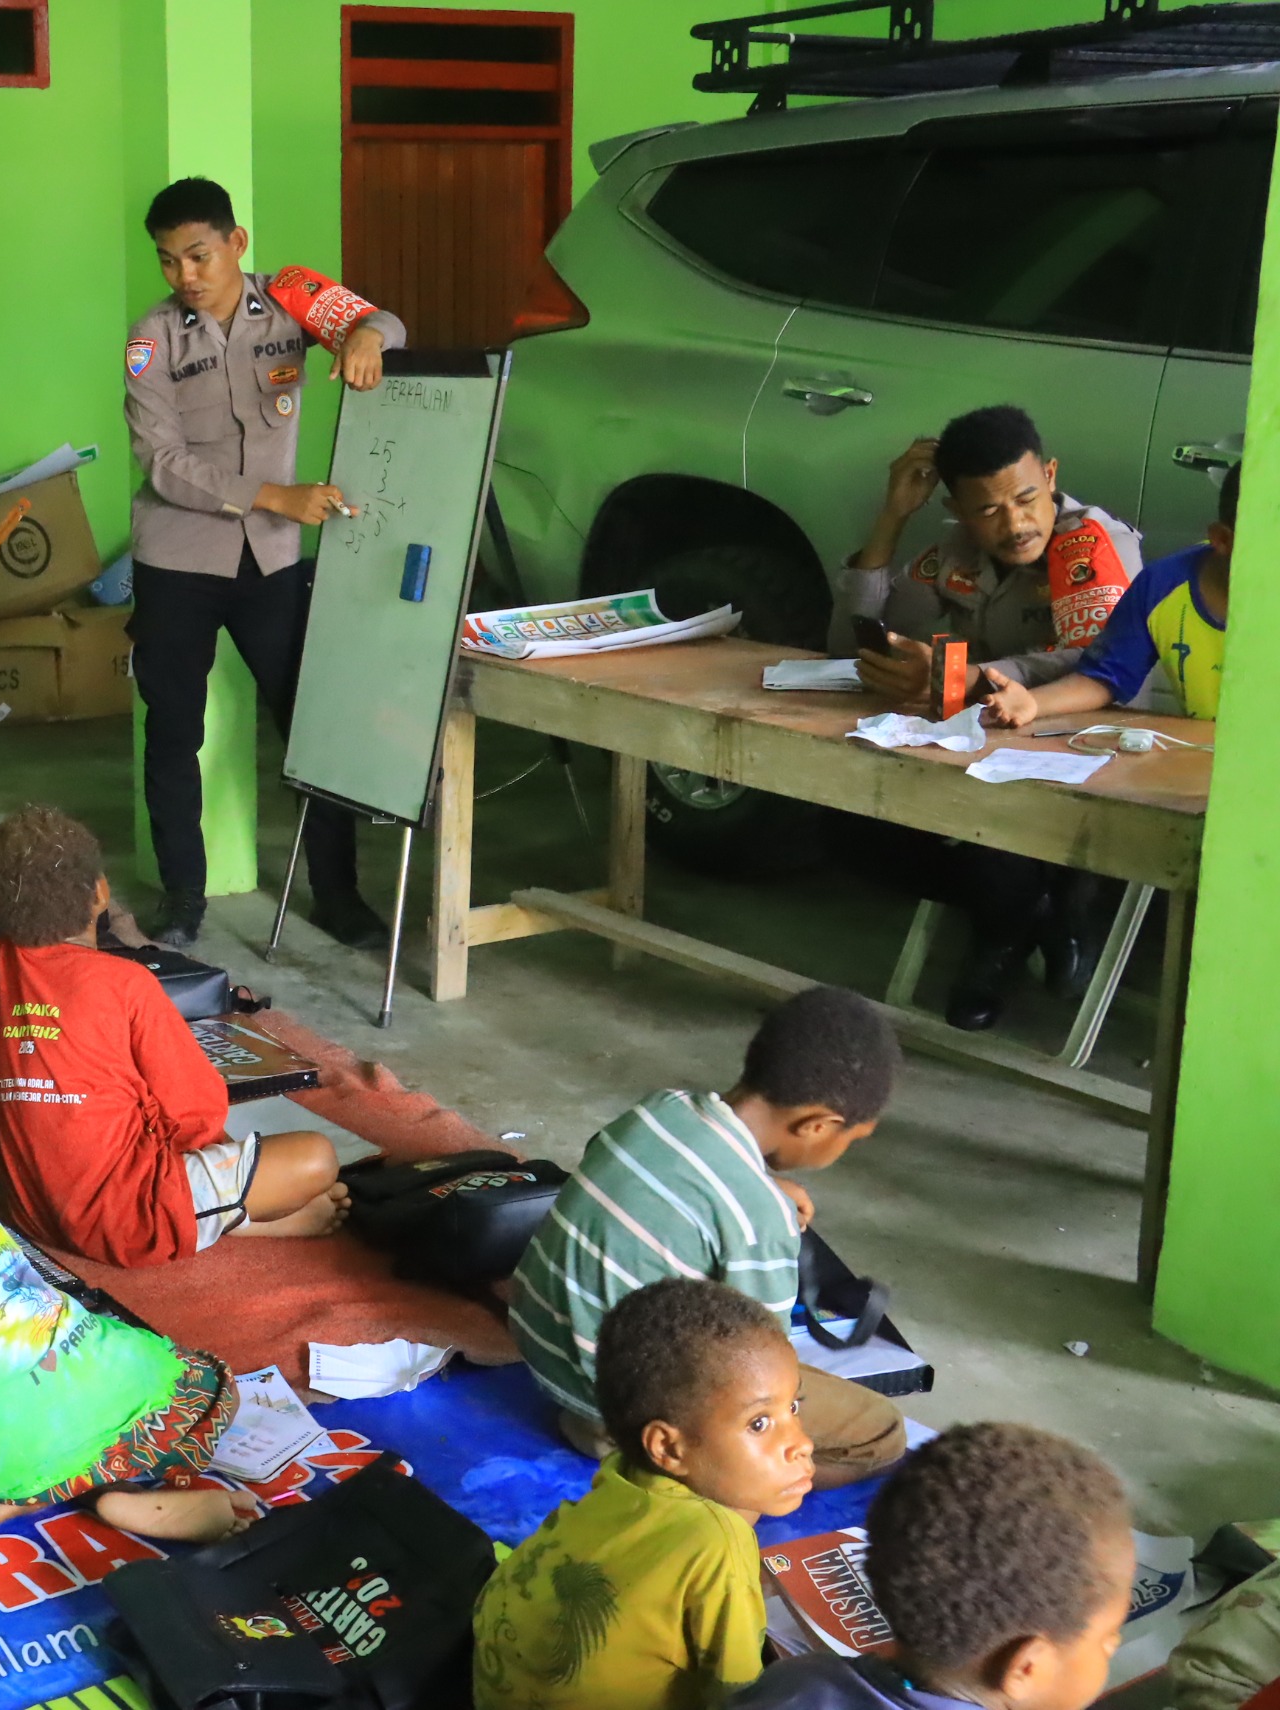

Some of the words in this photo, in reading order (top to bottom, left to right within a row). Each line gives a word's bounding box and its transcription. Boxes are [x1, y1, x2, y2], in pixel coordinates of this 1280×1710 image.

[253, 338, 302, 359] POLRI
[385, 379, 453, 411] PERKALIAN
[370, 437, 396, 463] 25
[1056, 535, 1097, 552] POLDA
[1075, 587, 1118, 601] RASAKA
[11, 1002, 60, 1018] RASAKA
[3, 1025, 61, 1040] CARTENZ
[27, 1079, 54, 1090] ADALAH
[59, 1313, 99, 1355] PAPUA
[801, 1548, 895, 1649] RASAKA
